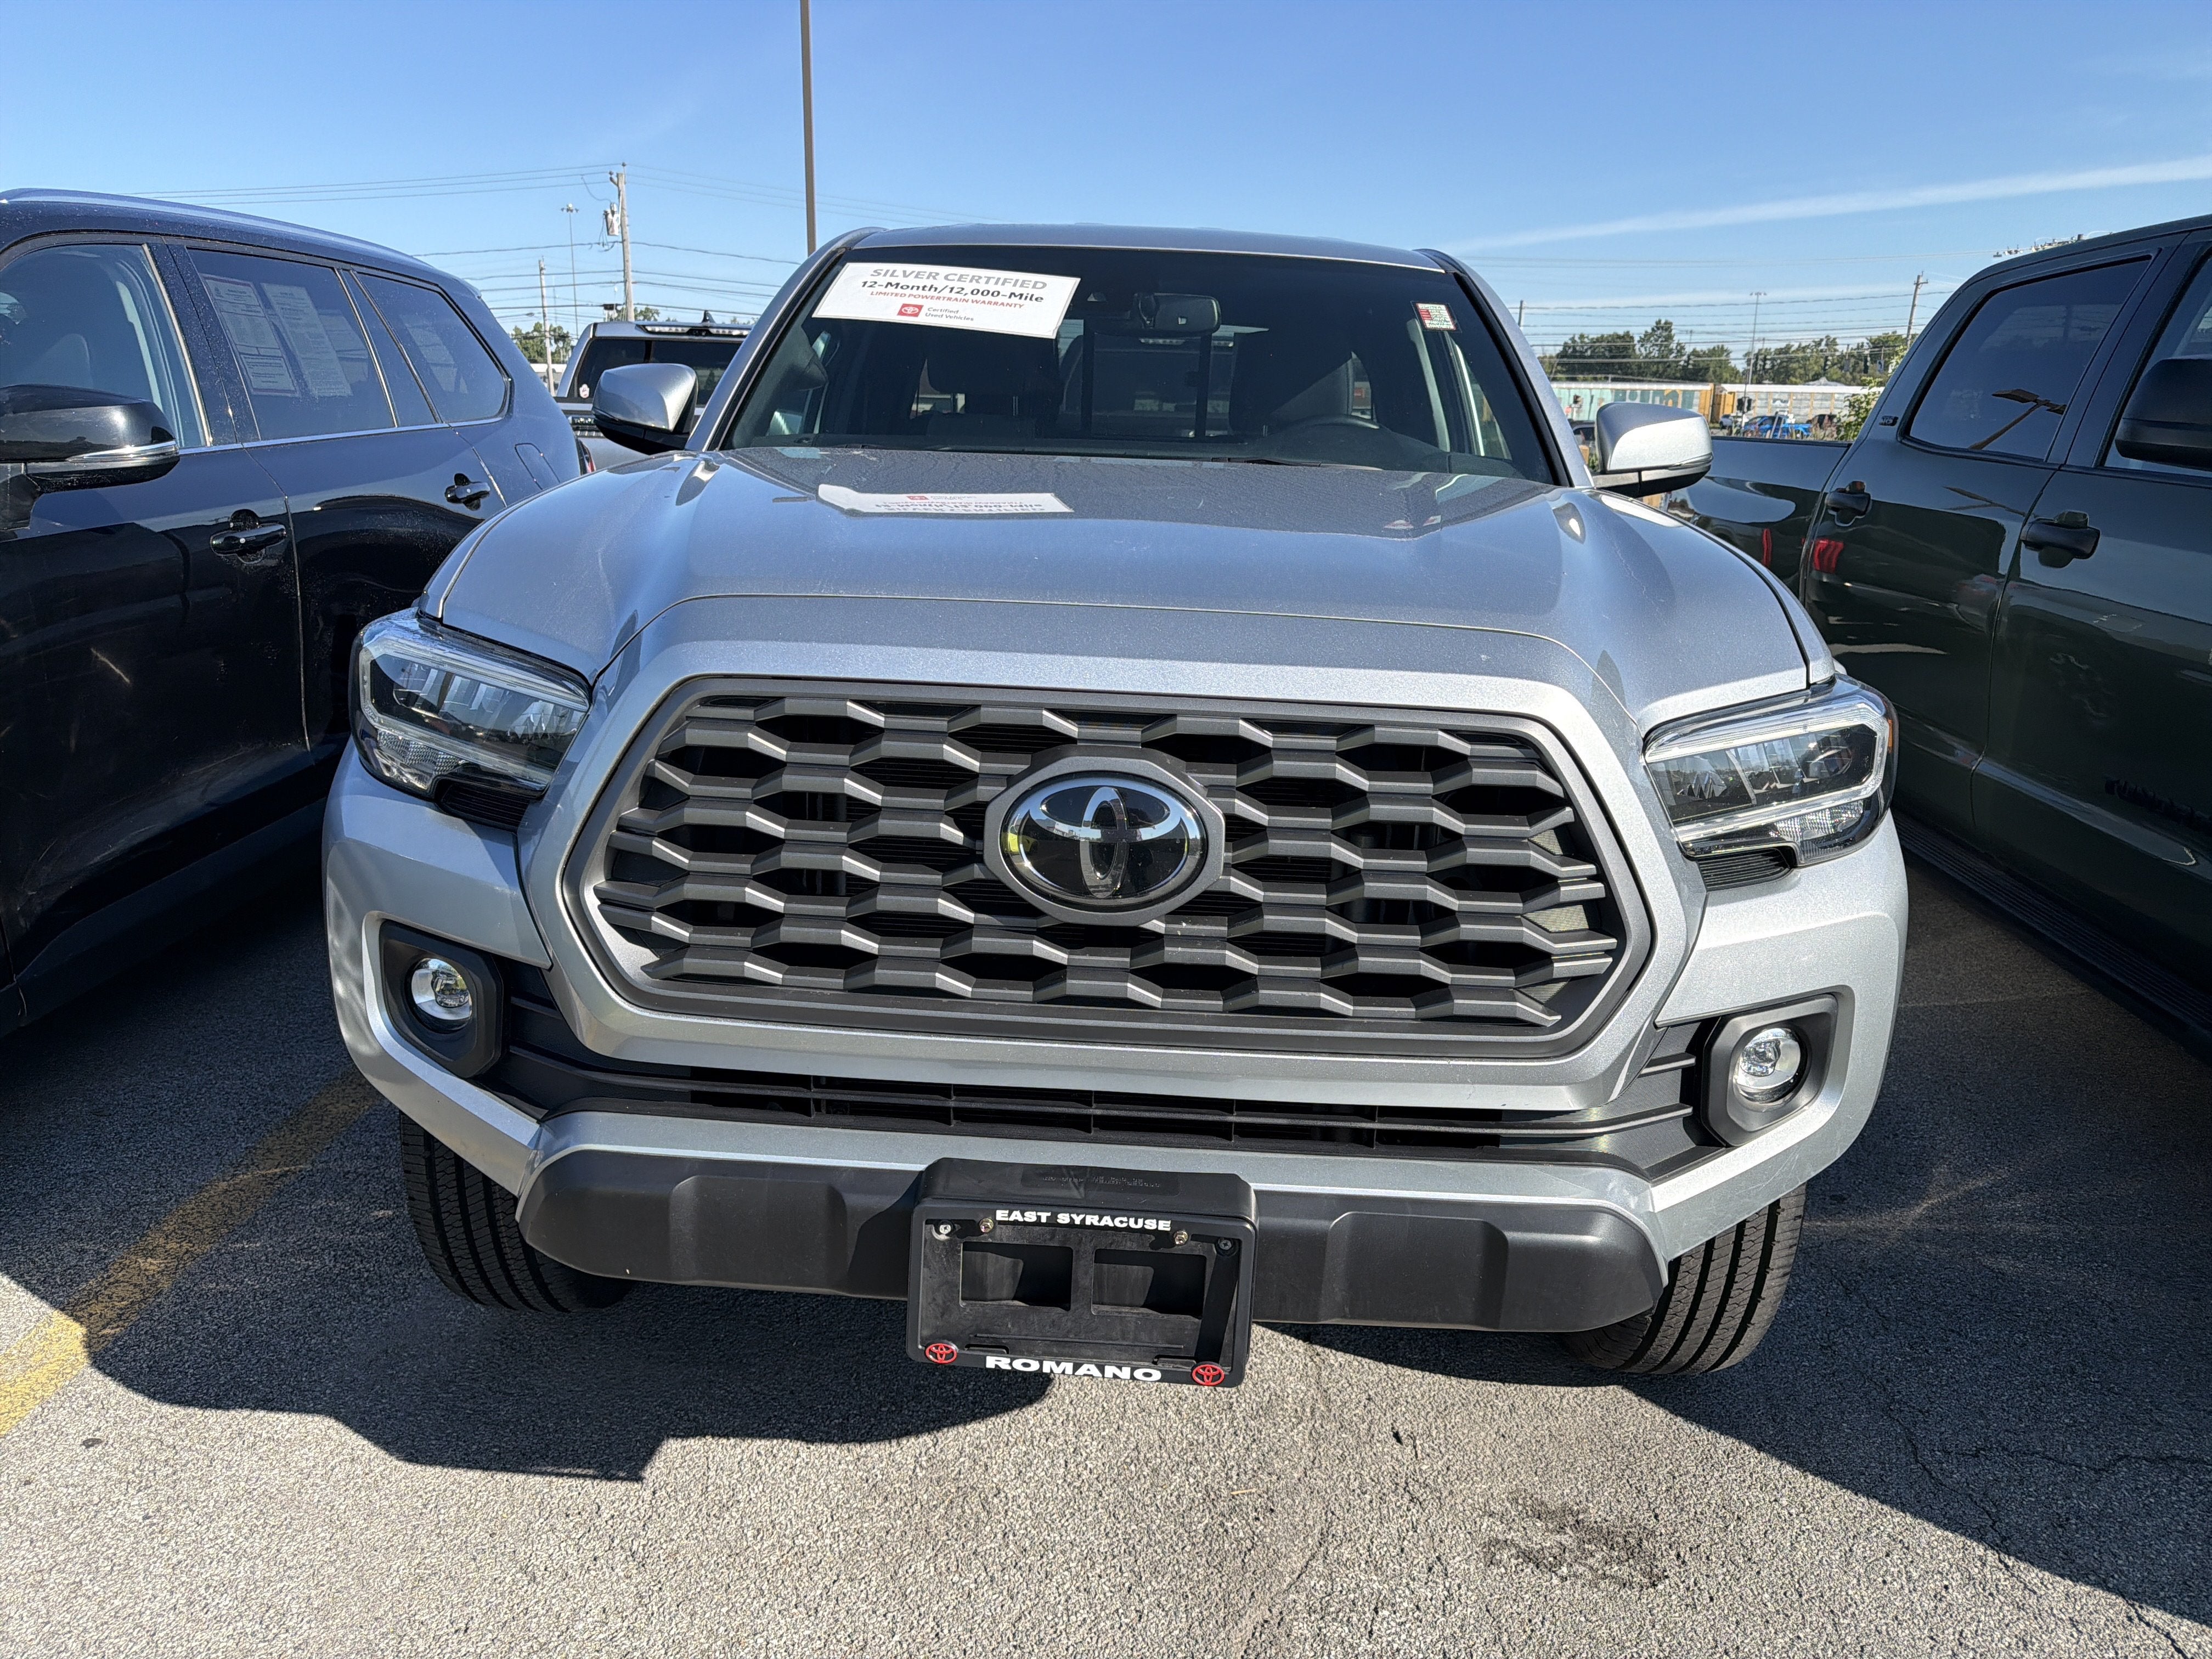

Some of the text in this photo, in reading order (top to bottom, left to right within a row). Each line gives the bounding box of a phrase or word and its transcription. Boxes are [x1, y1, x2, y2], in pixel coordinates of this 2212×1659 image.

[870, 269, 1047, 290] SILVER CERTIFIED
[861, 280, 1044, 302] 12-Month/12,000-Mile
[908, 294, 969, 303] POWERTRAIN
[970, 299, 1024, 309] WARRANTY
[996, 1209, 1171, 1231] EAST SYRACUSE
[985, 1355, 1162, 1381] ROMANO
